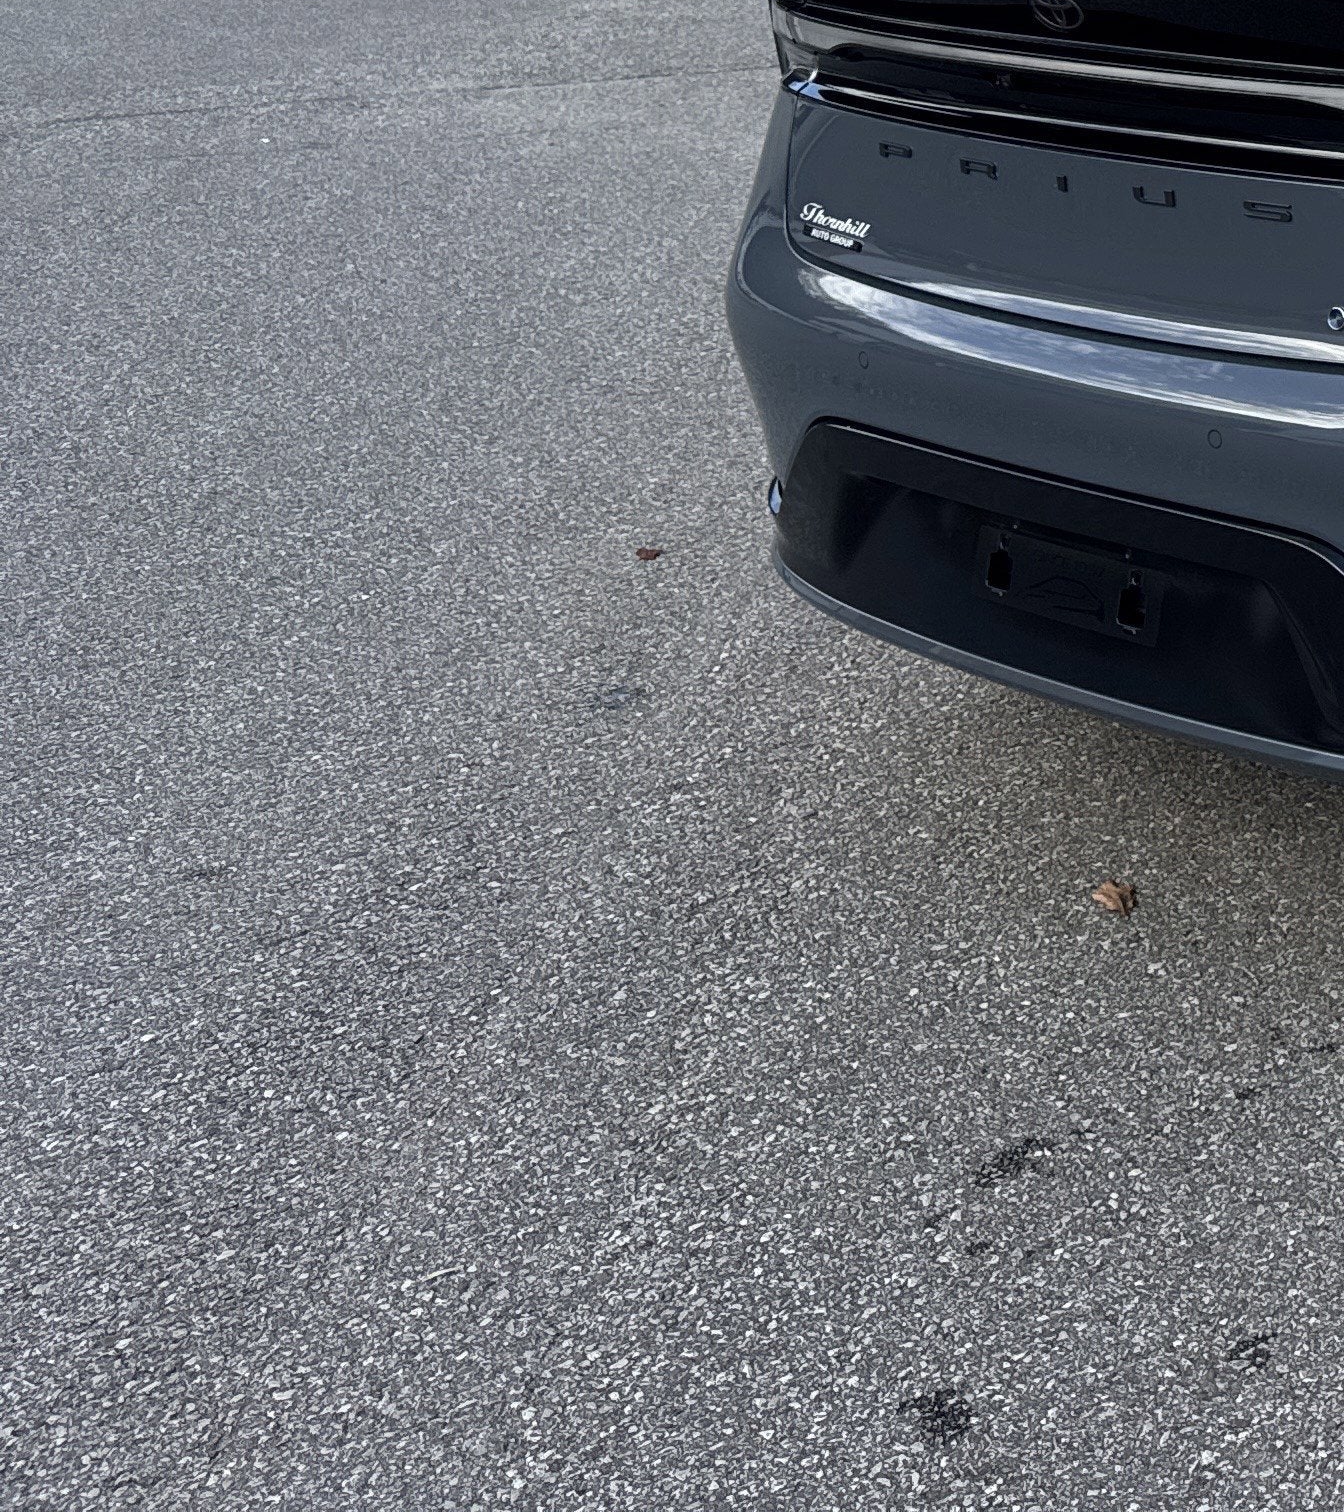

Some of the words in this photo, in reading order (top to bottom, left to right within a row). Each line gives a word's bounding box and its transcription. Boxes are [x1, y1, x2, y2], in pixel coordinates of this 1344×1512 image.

[879, 142, 1293, 222] PRIUS
[800, 202, 870, 238] Thornhill
[811, 228, 830, 241] AUTO
[829, 234, 854, 248] GROUP
